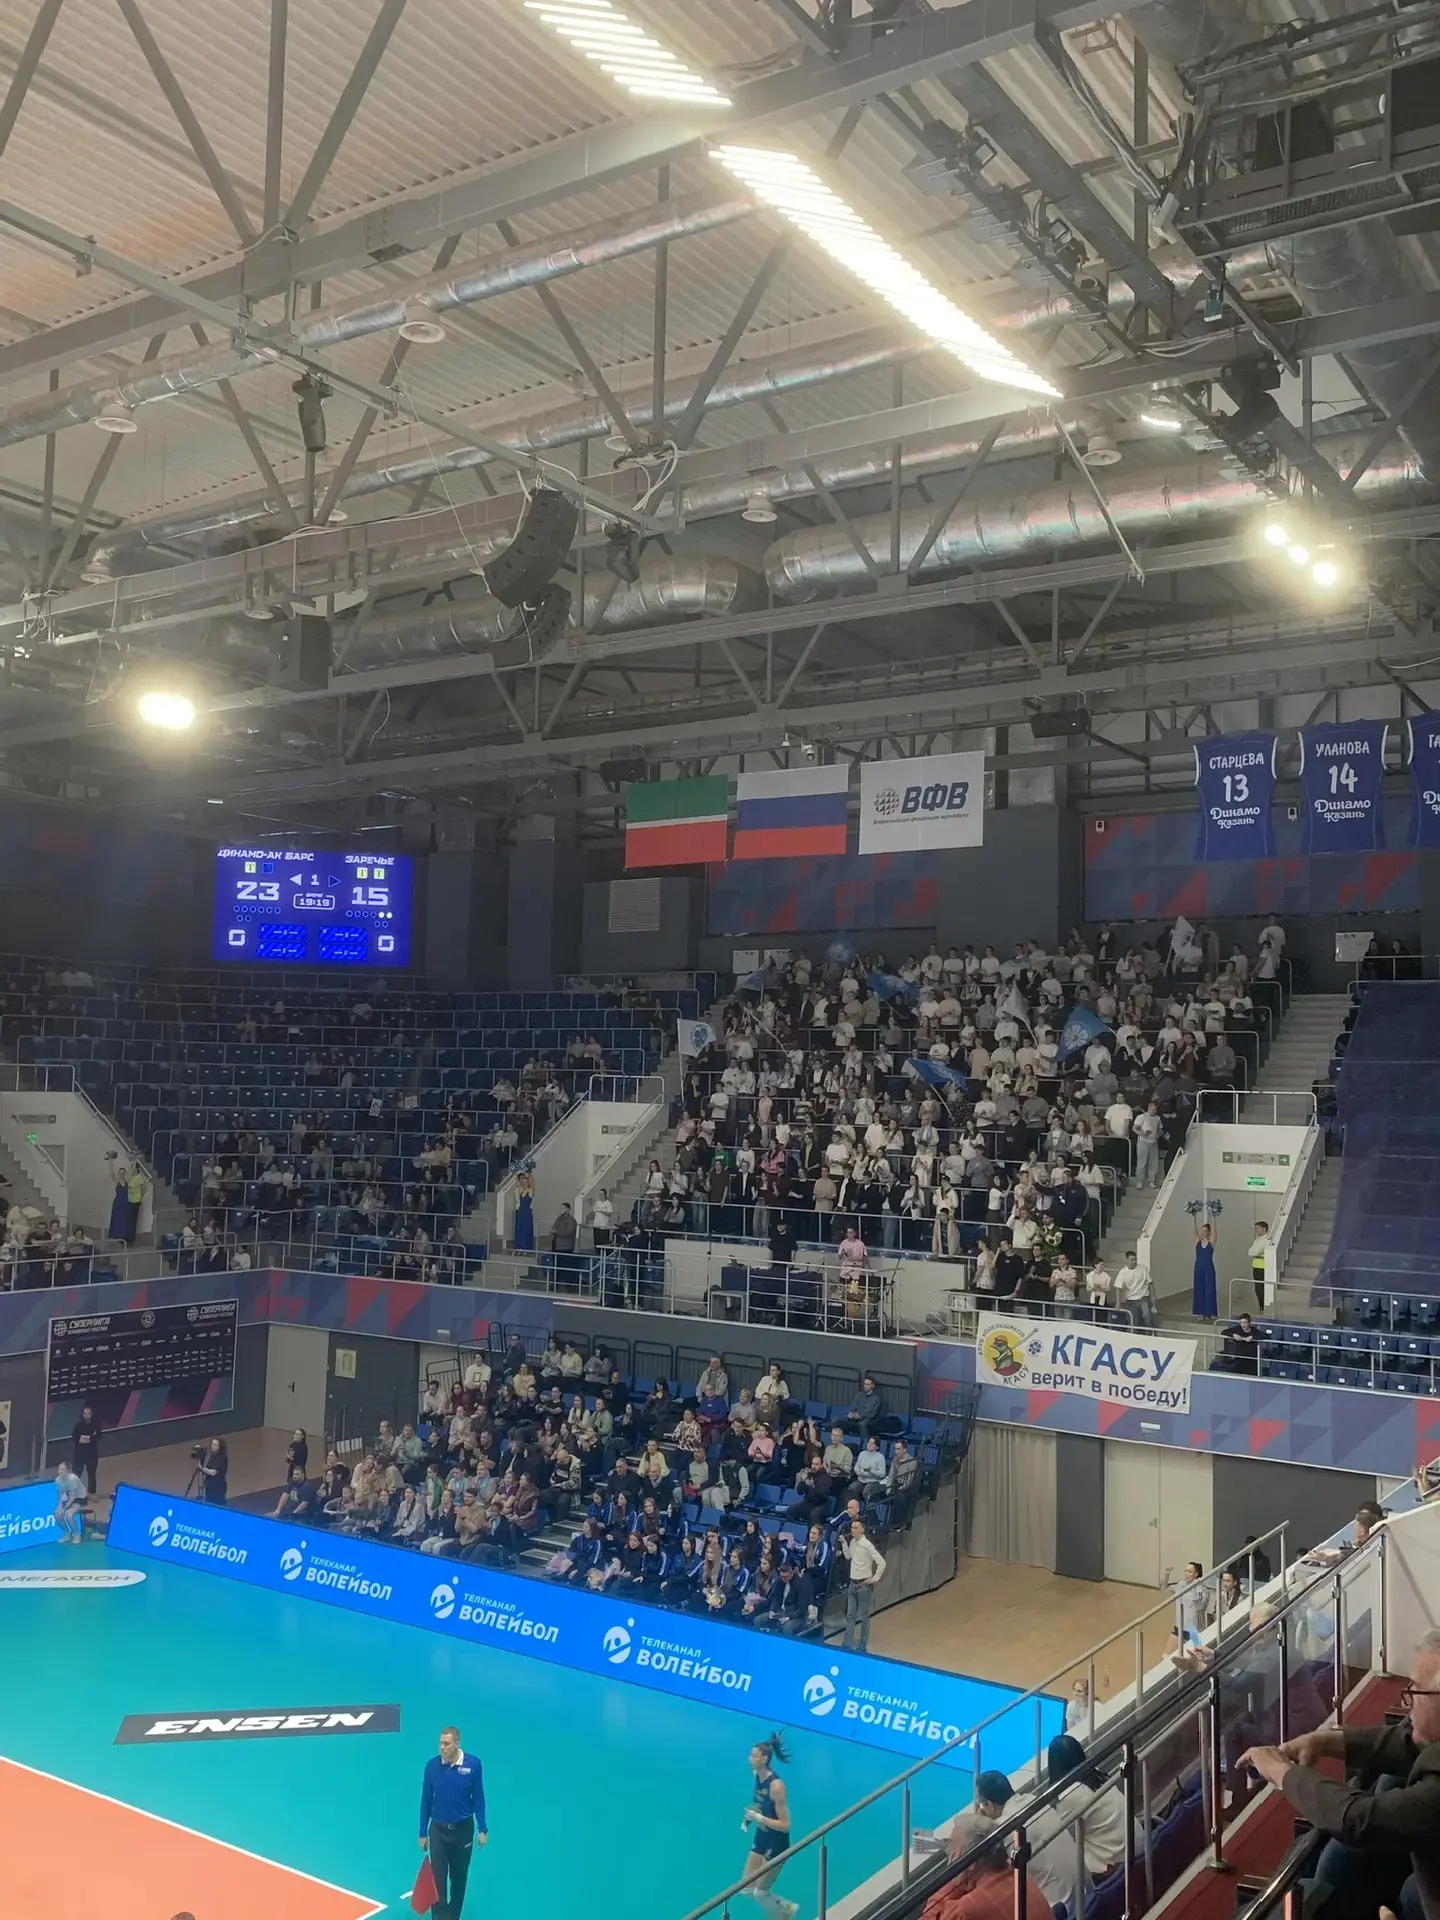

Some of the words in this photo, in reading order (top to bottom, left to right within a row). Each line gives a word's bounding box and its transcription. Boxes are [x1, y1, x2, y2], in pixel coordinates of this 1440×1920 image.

[1316, 741, 1370, 757] УЛАНОВА
[1209, 752, 1265, 770] СТАРЦЕВА
[1222, 773, 1250, 803] 13
[1328, 762, 1358, 794] 14
[900, 781, 969, 814] ВФВ
[1314, 799, 1371, 813] Динамо
[1210, 806, 1260, 820] Динамо
[217, 848, 282, 860] ДИНАМО-АК
[284, 852, 315, 862] БАРС
[344, 855, 396, 866] ЗАРЕЧЬЕ
[236, 880, 280, 901] 23
[311, 874, 320, 886] 1
[351, 886, 389, 906] 15
[228, 929, 246, 946] 0
[377, 935, 395, 952] 0
[1050, 1334, 1175, 1381] КГАСУ
[1003, 1364, 1029, 1385] КГАСУ
[1031, 1372, 1085, 1389] верит
[1091, 1380, 1102, 1393] в
[1108, 1382, 1187, 1407] победу!
[175, 1523, 216, 1539] ТЕЛЕКАНАЛ
[170, 1533, 248, 1564] ВОЛЕЙБОЛ
[310, 1555, 356, 1573] ТЕЛЕКАНАЛ
[305, 1567, 393, 1601] ВОЛЕЙБОЛ
[463, 1592, 516, 1612] ТЕЛЕКАНАЛ
[458, 1604, 560, 1643] ВОЛЕЙБОЛ
[641, 1635, 702, 1658] ТЕЛЕКАНАЛ
[636, 1649, 752, 1692] ВОЛЕЙБОЛ
[847, 1685, 918, 1712] ТЕЛЕКАНАЛ
[144, 1711, 374, 1736] ENSEN
